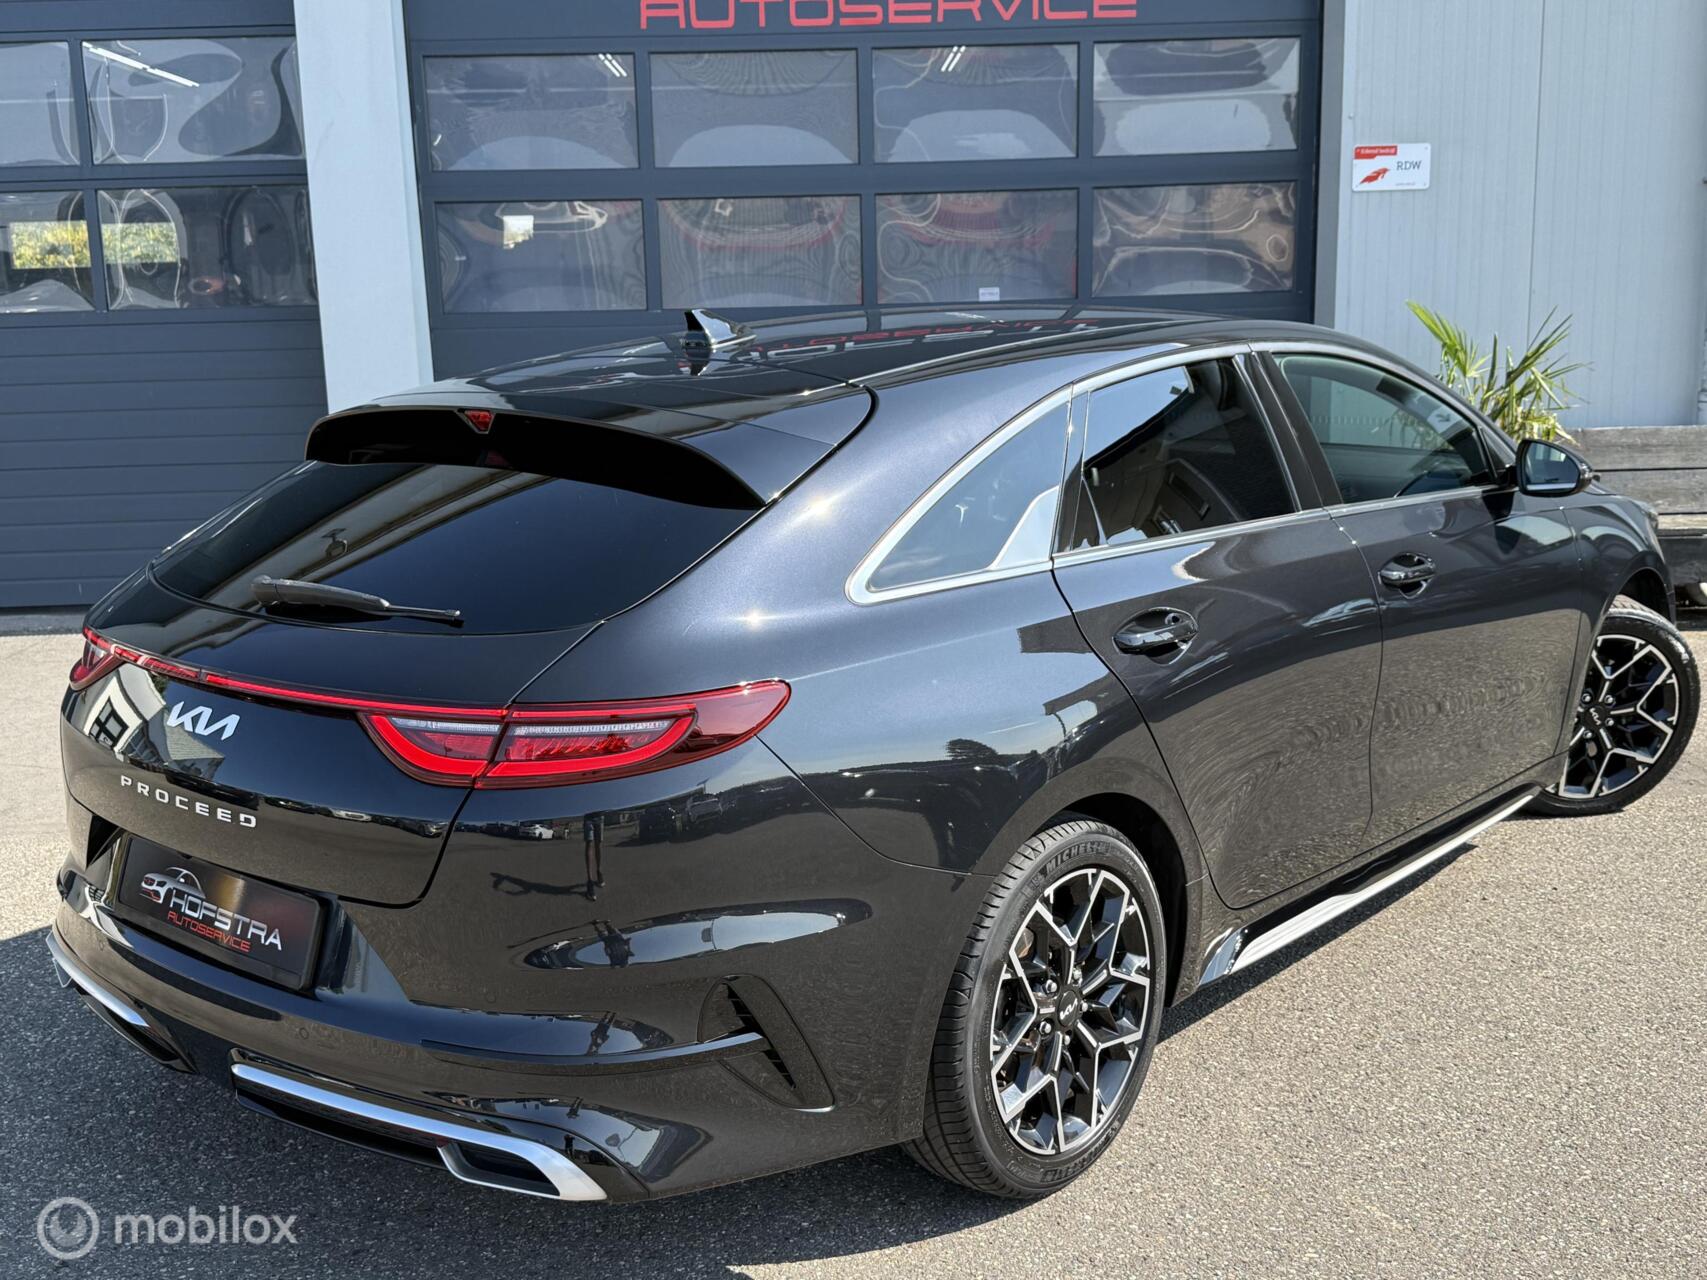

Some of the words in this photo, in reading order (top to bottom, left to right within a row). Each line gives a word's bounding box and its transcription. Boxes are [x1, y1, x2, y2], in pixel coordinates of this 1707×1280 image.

[640, 0, 1138, 29] AUTOSERVICE
[1396, 160, 1422, 171] RDW
[166, 701, 241, 741] KIA
[120, 775, 257, 828] PROCEED
[167, 911, 252, 953] AUTOSERVICE
[169, 889, 282, 951] HOFSTRA
